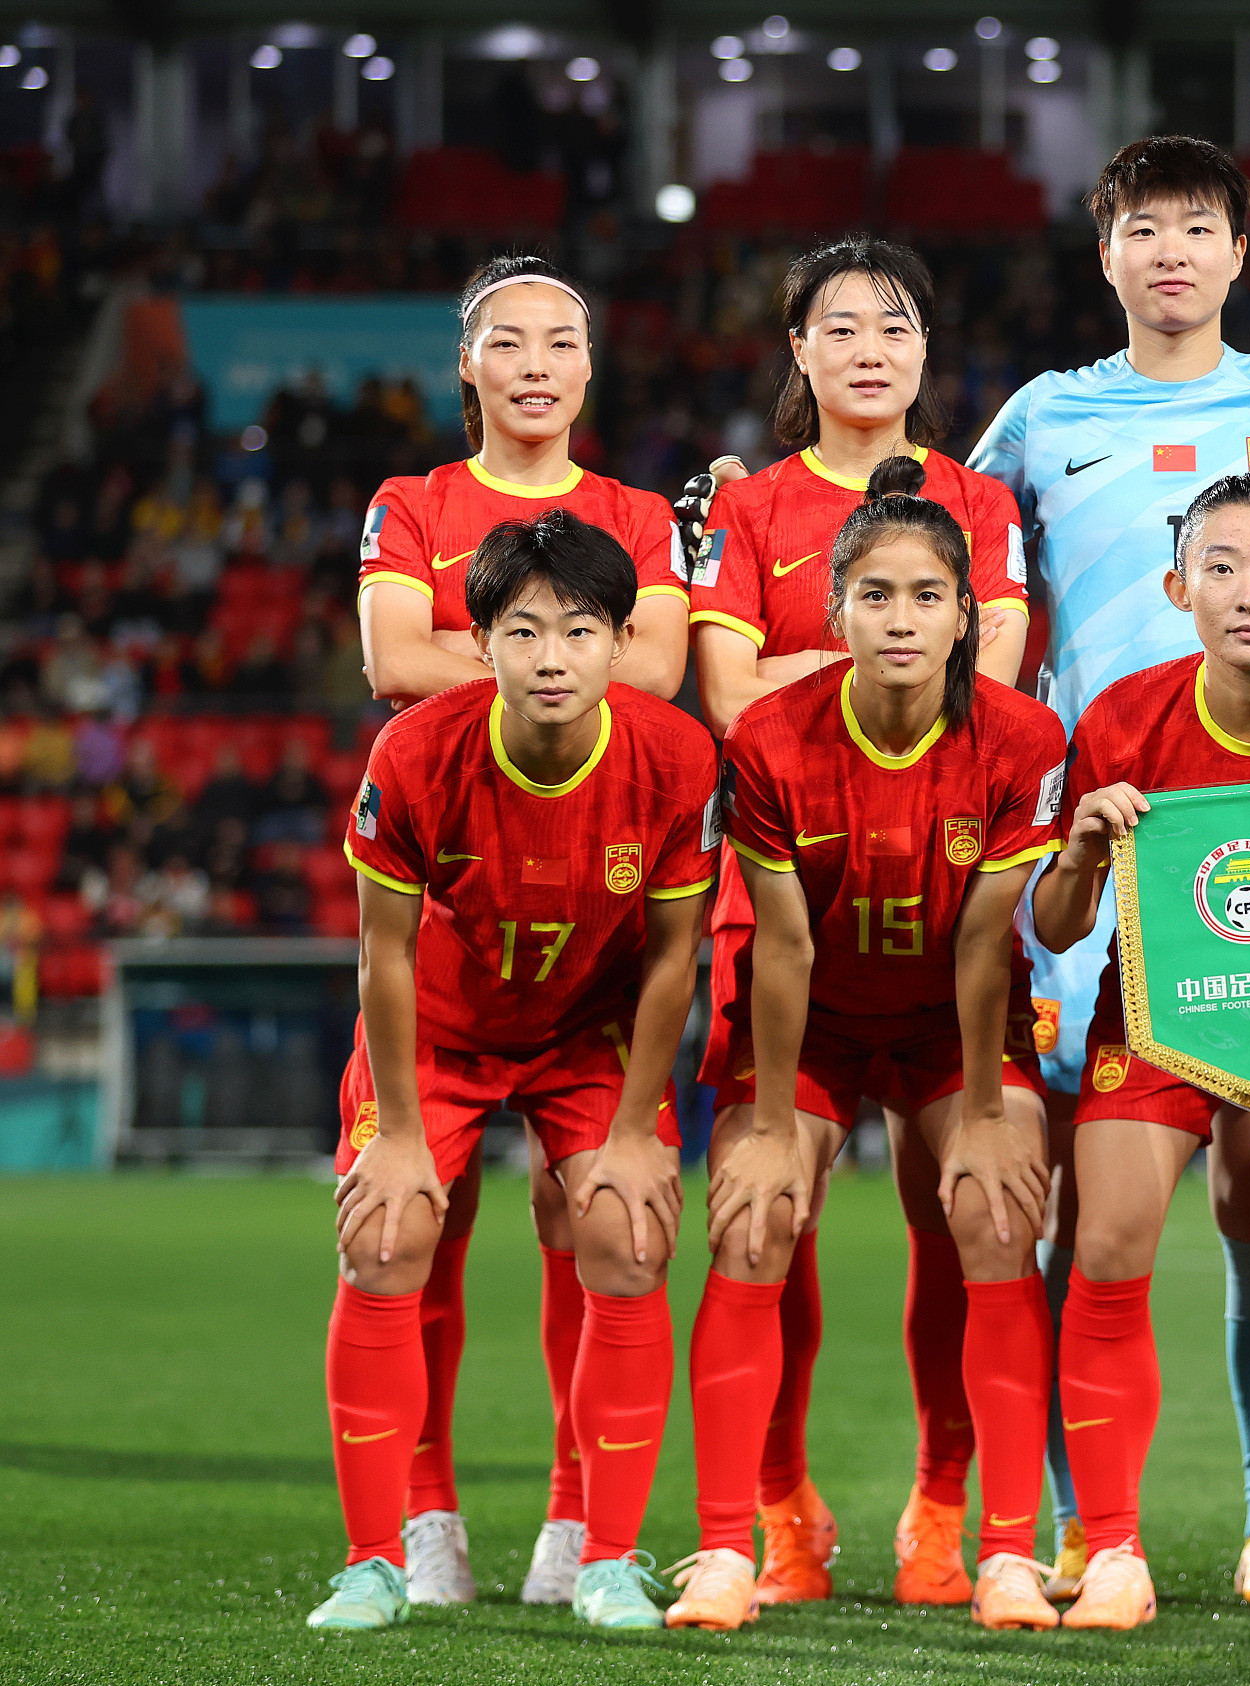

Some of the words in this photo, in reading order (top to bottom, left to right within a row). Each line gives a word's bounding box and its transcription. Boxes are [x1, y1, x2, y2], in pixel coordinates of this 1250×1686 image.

[948, 820, 979, 831] CFA
[608, 846, 639, 859] CFA
[852, 894, 923, 956] 15
[498, 921, 576, 982] 17
[1178, 1003, 1218, 1014] CHINESE
